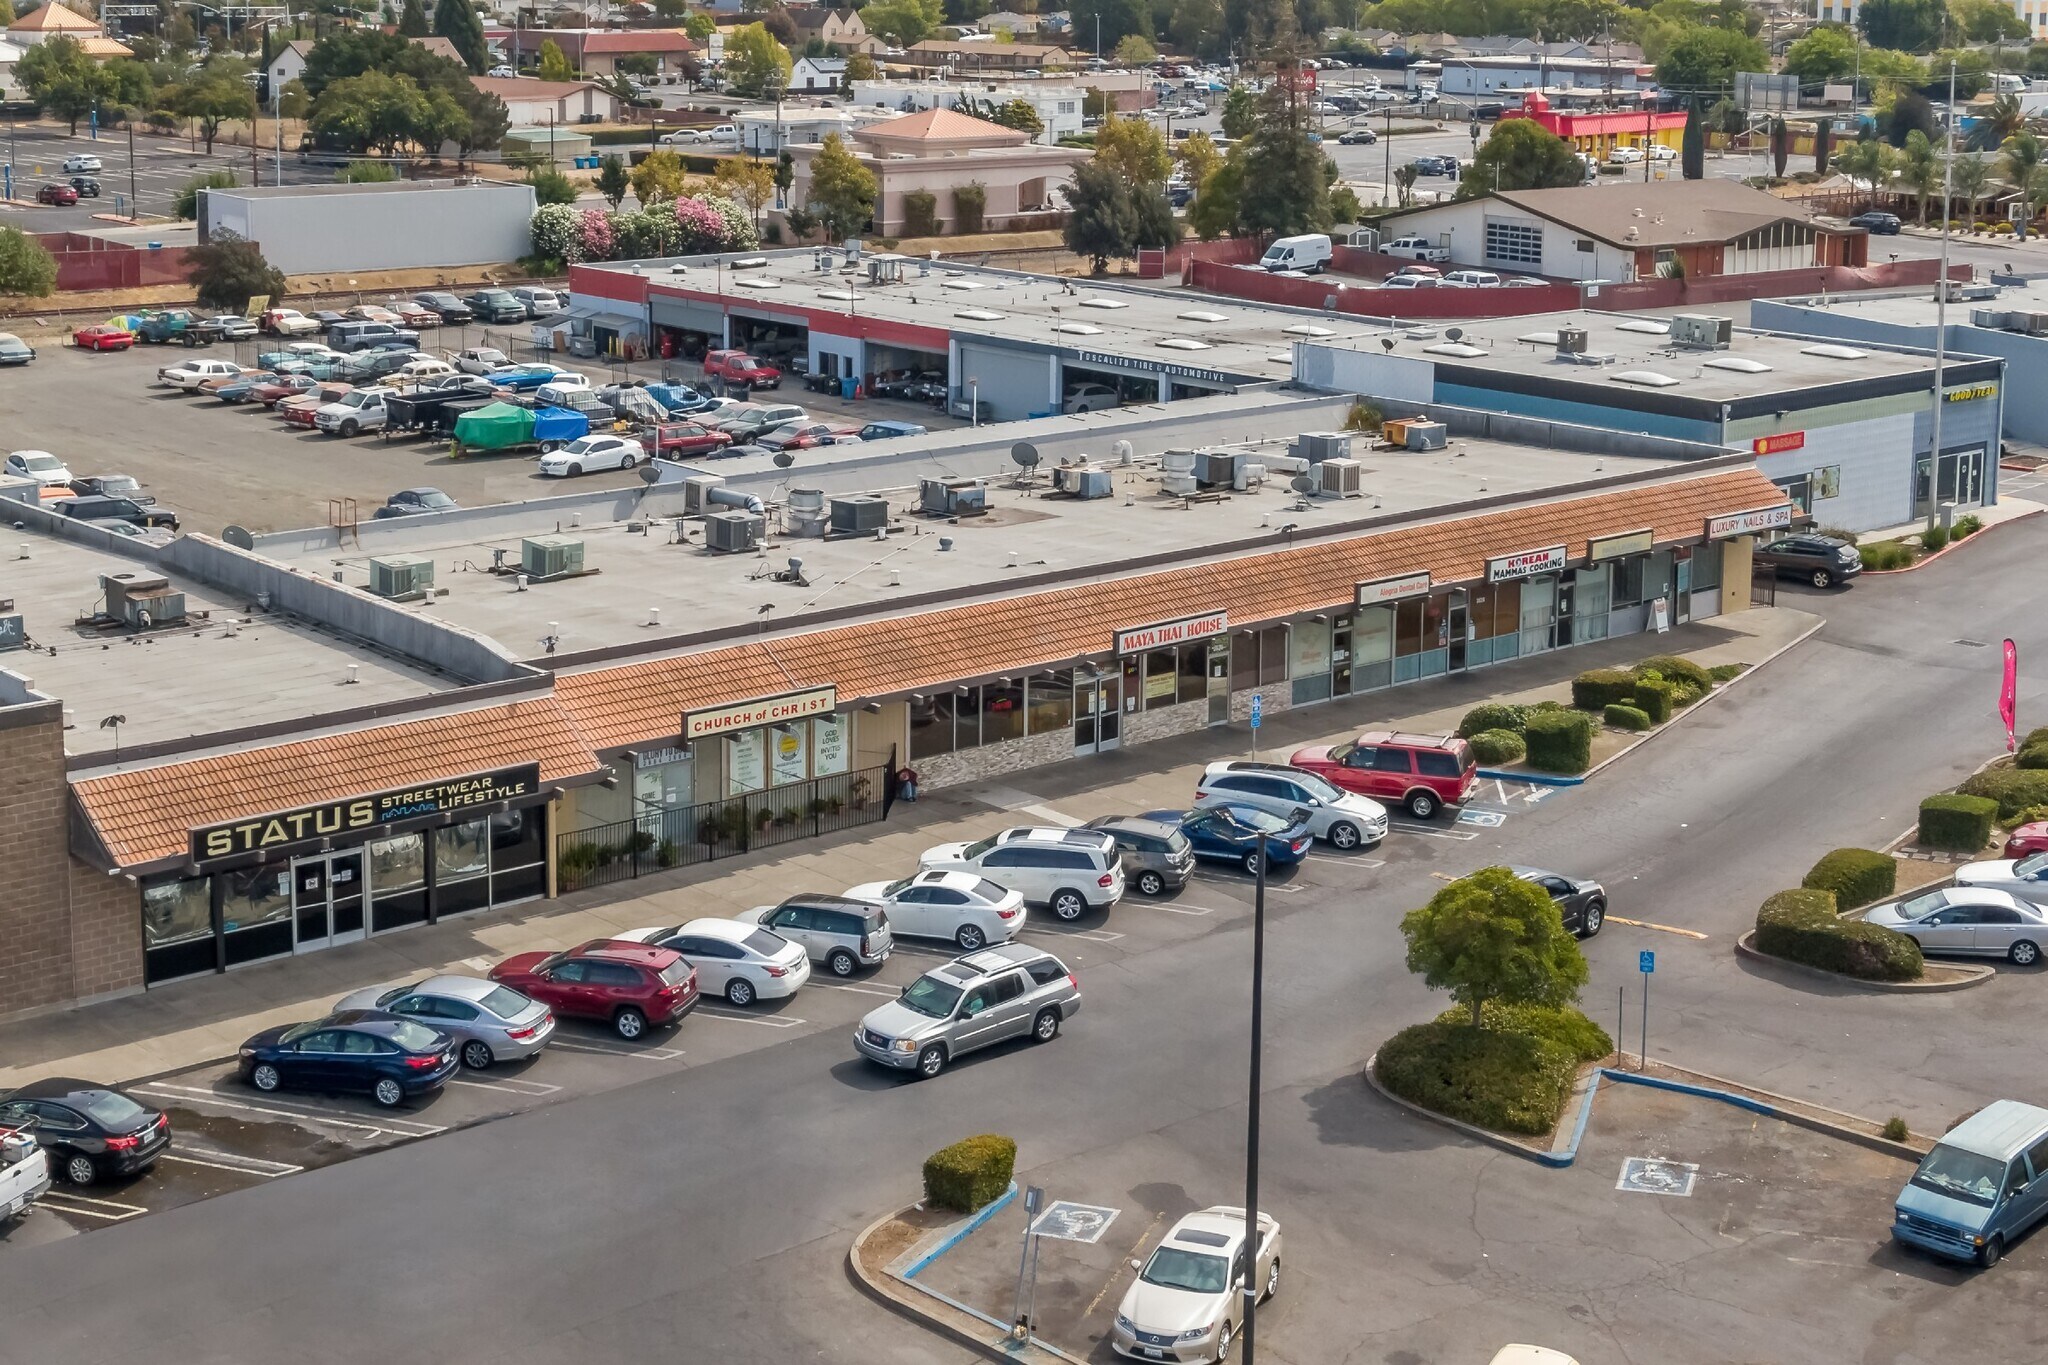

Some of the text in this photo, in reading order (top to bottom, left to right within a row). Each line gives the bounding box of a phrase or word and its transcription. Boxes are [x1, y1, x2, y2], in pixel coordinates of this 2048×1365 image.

[1133, 360, 1153, 371] TIRE
[1165, 365, 1225, 382] AUTOMOTIVE
[1769, 434, 1802, 450] MASSAGE
[1711, 510, 1789, 534] LUXURY NAILS & SPA
[1493, 556, 1563, 580] MAMMAS COOKING
[1508, 552, 1549, 568] KOREAN
[1399, 583, 1415, 594] Dental
[1416, 581, 1428, 591] Care
[1123, 617, 1223, 651] MAYA THAI HOUSE
[694, 698, 827, 732] CHURCH of CHRIST
[822, 736, 840, 745] LOVES
[824, 729, 838, 738] GOD
[820, 745, 842, 754] INVITES
[824, 752, 838, 760] YOU
[381, 777, 493, 809] STREETWEAR
[207, 782, 526, 856] STATUS LIFESTYLE
